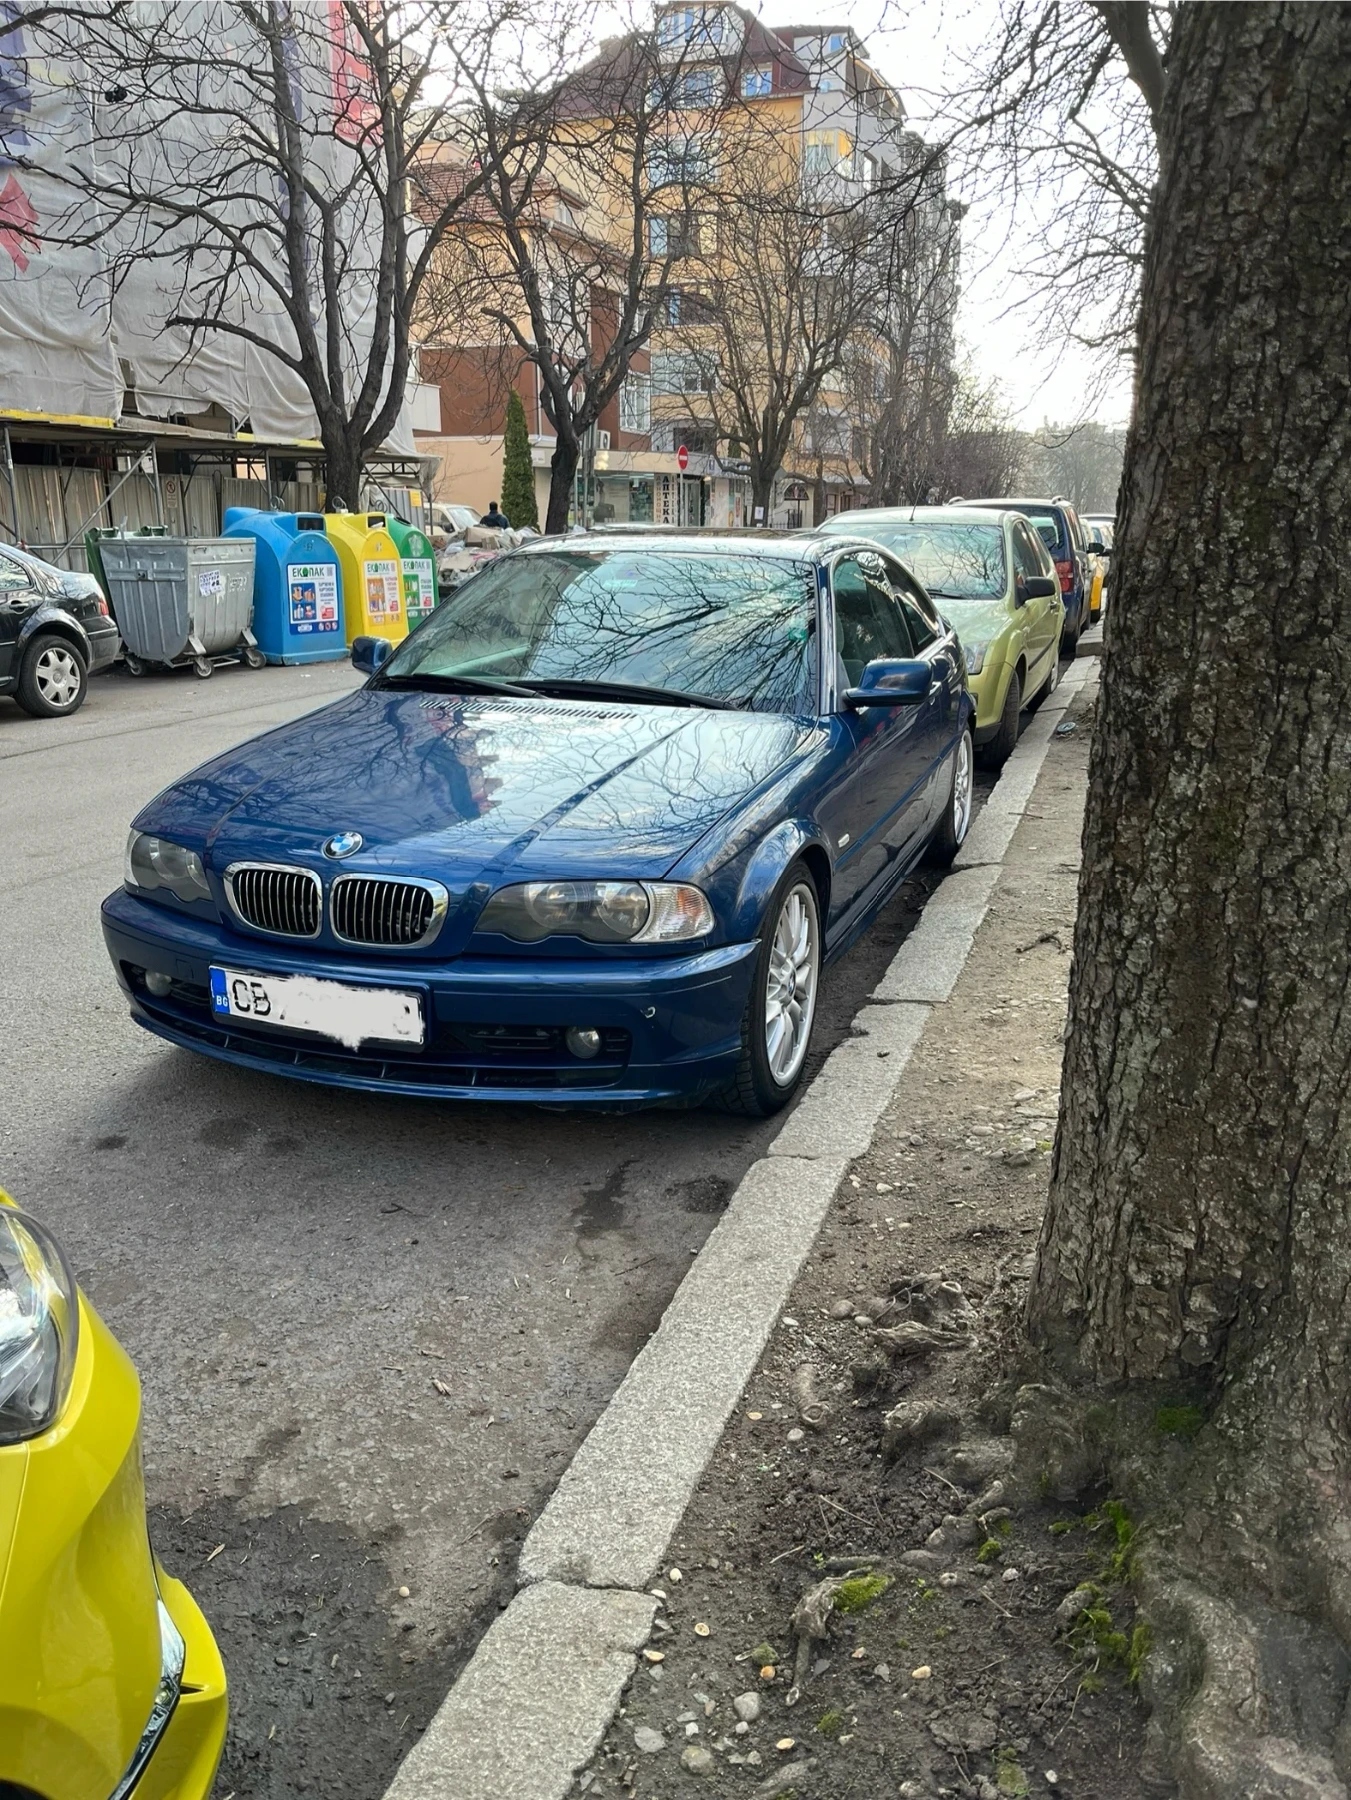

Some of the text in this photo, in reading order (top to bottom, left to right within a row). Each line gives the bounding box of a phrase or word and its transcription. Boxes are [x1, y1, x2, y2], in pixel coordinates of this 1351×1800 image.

[662, 475, 670, 524] АПТЕКА
[367, 562, 390, 573] ЕКОПАК
[402, 560, 425, 570] ЕКОПАК
[292, 566, 325, 578] ЕКОПАК
[216, 995, 228, 1007] BG
